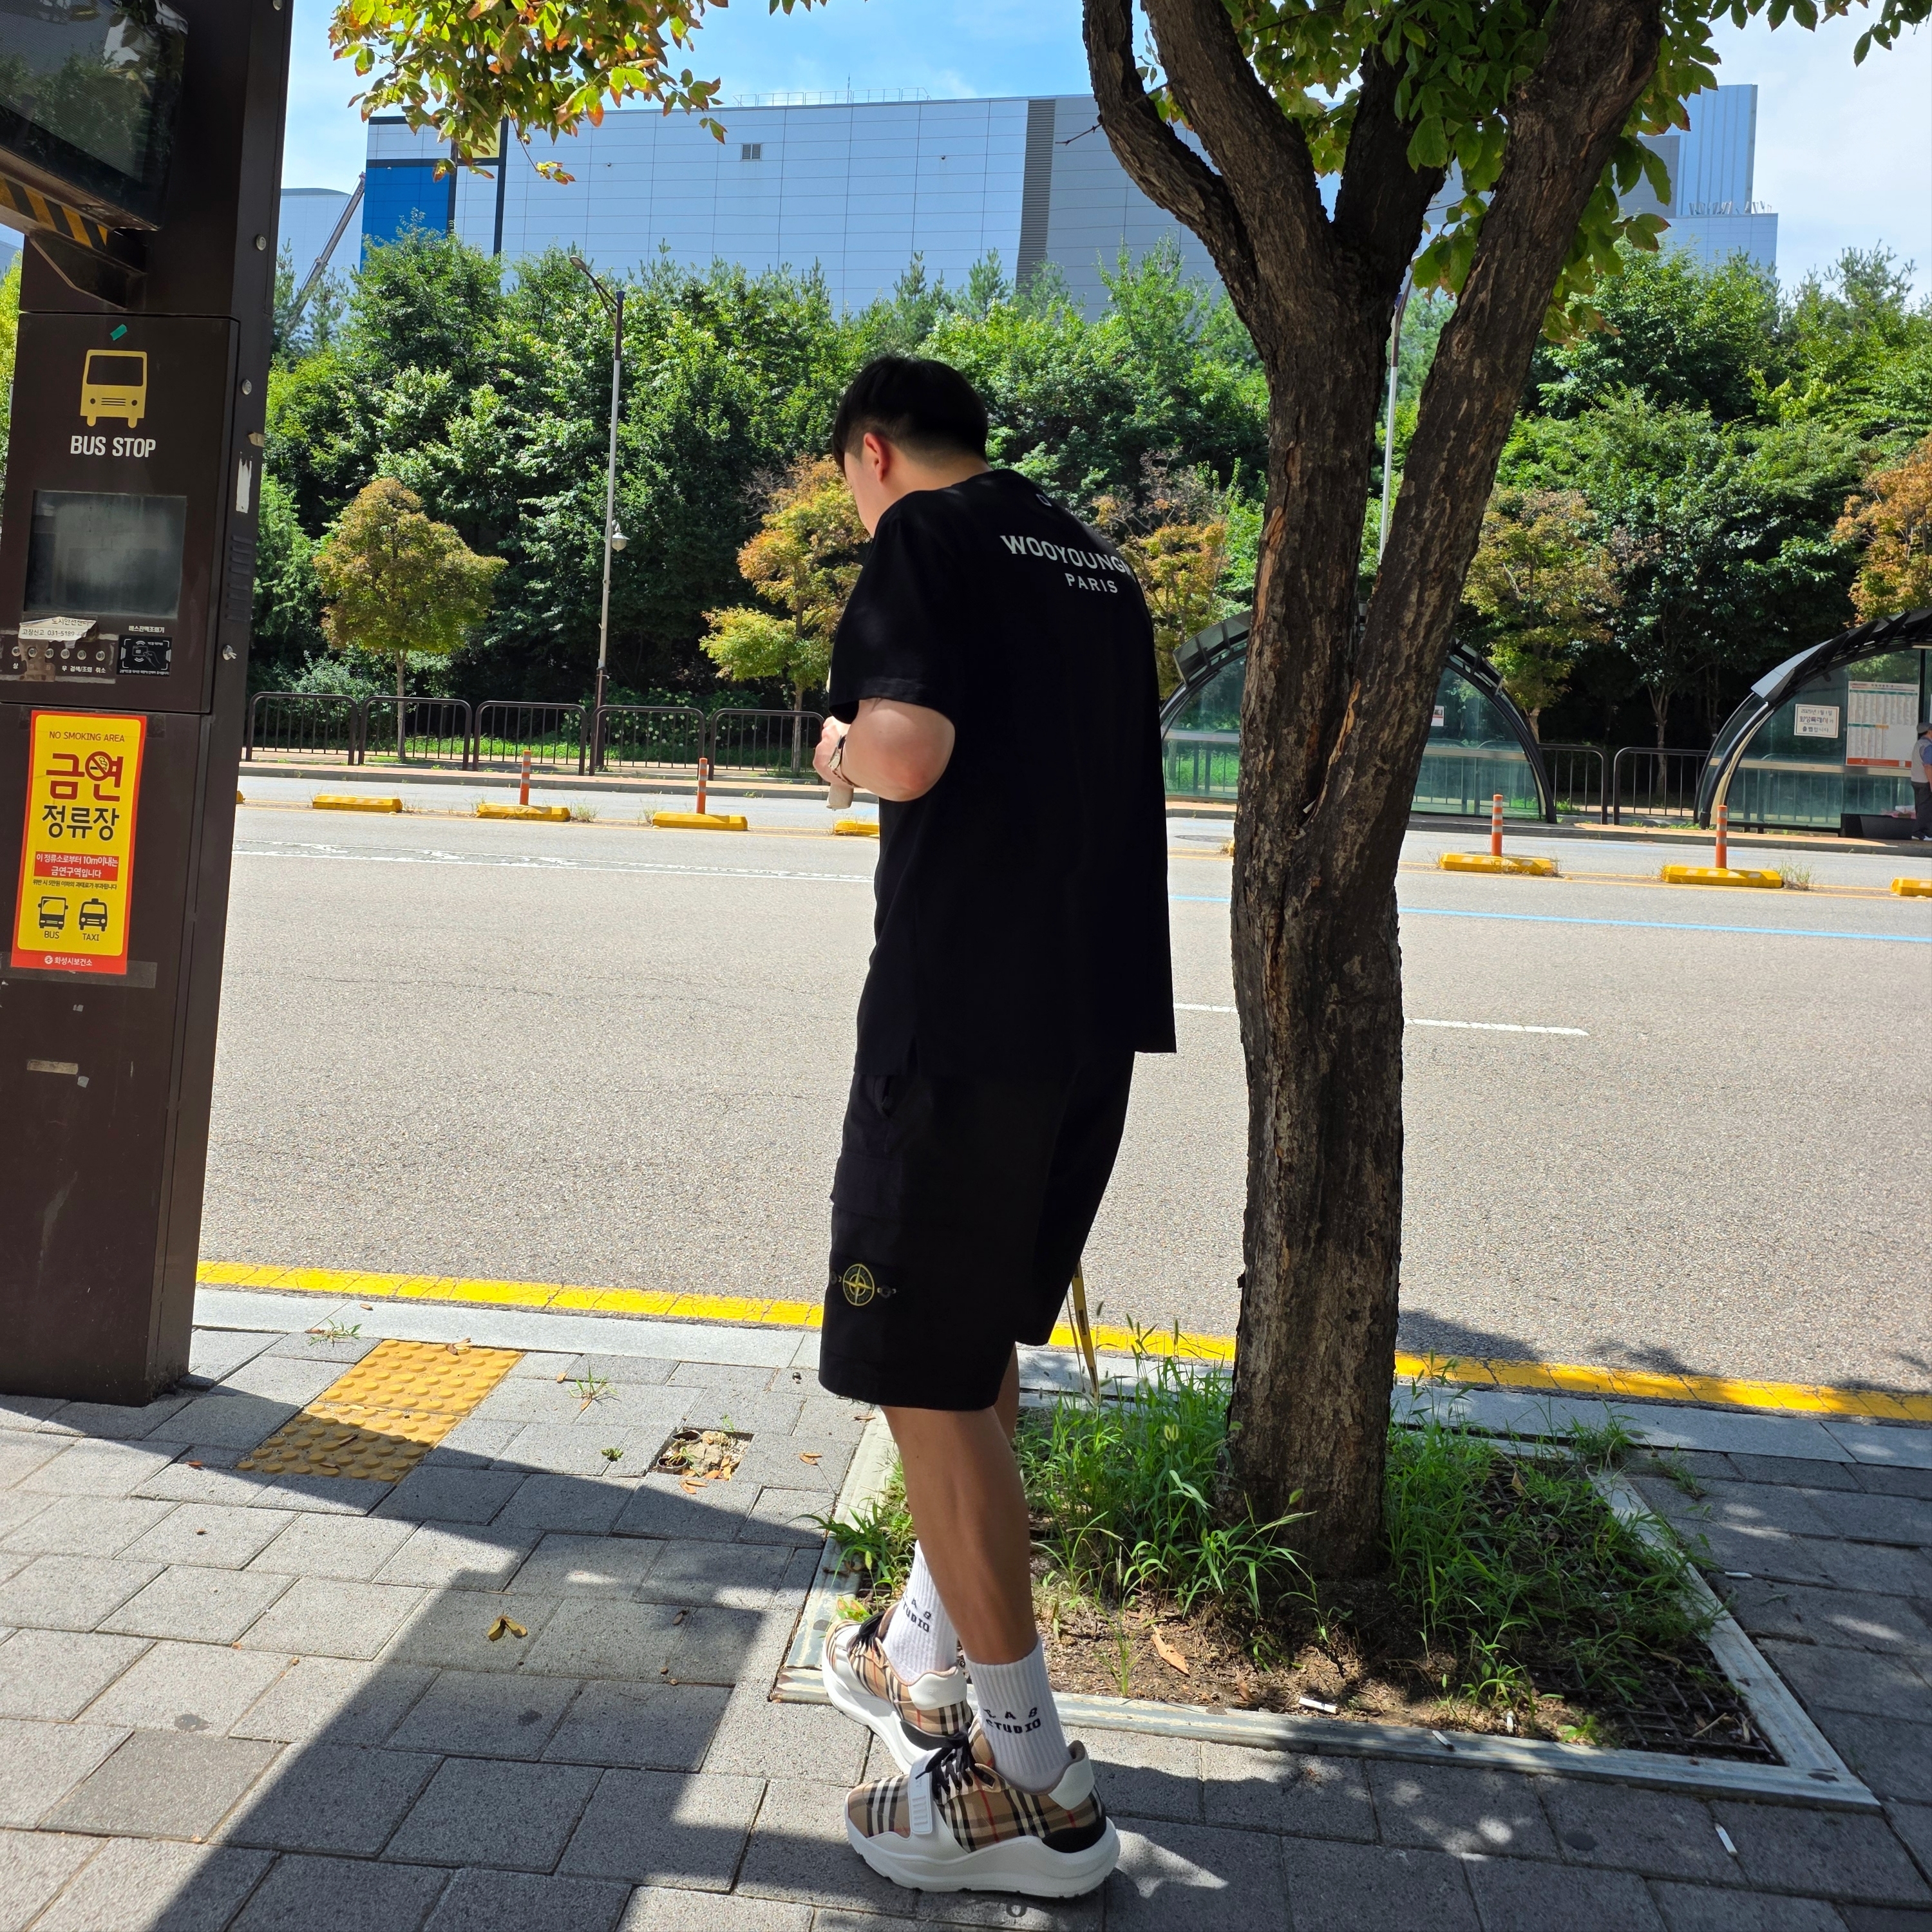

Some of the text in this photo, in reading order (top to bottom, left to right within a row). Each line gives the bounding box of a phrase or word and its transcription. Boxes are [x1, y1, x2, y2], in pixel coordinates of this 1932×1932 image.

[70, 435, 156, 458] BUS STOP
[1065, 573, 1118, 594] PARIS
[63, 732, 101, 741] SMOKING
[46, 751, 124, 802] 금연
[42, 805, 120, 841] 정류장
[36, 853, 118, 867] 이 정류소로부터 10m이내는
[51, 866, 102, 878] 금연구역입니다
[44, 931, 59, 939] BUS
[54, 956, 93, 967] 화성시보건소
[902, 1596, 930, 1633] TUDIO
